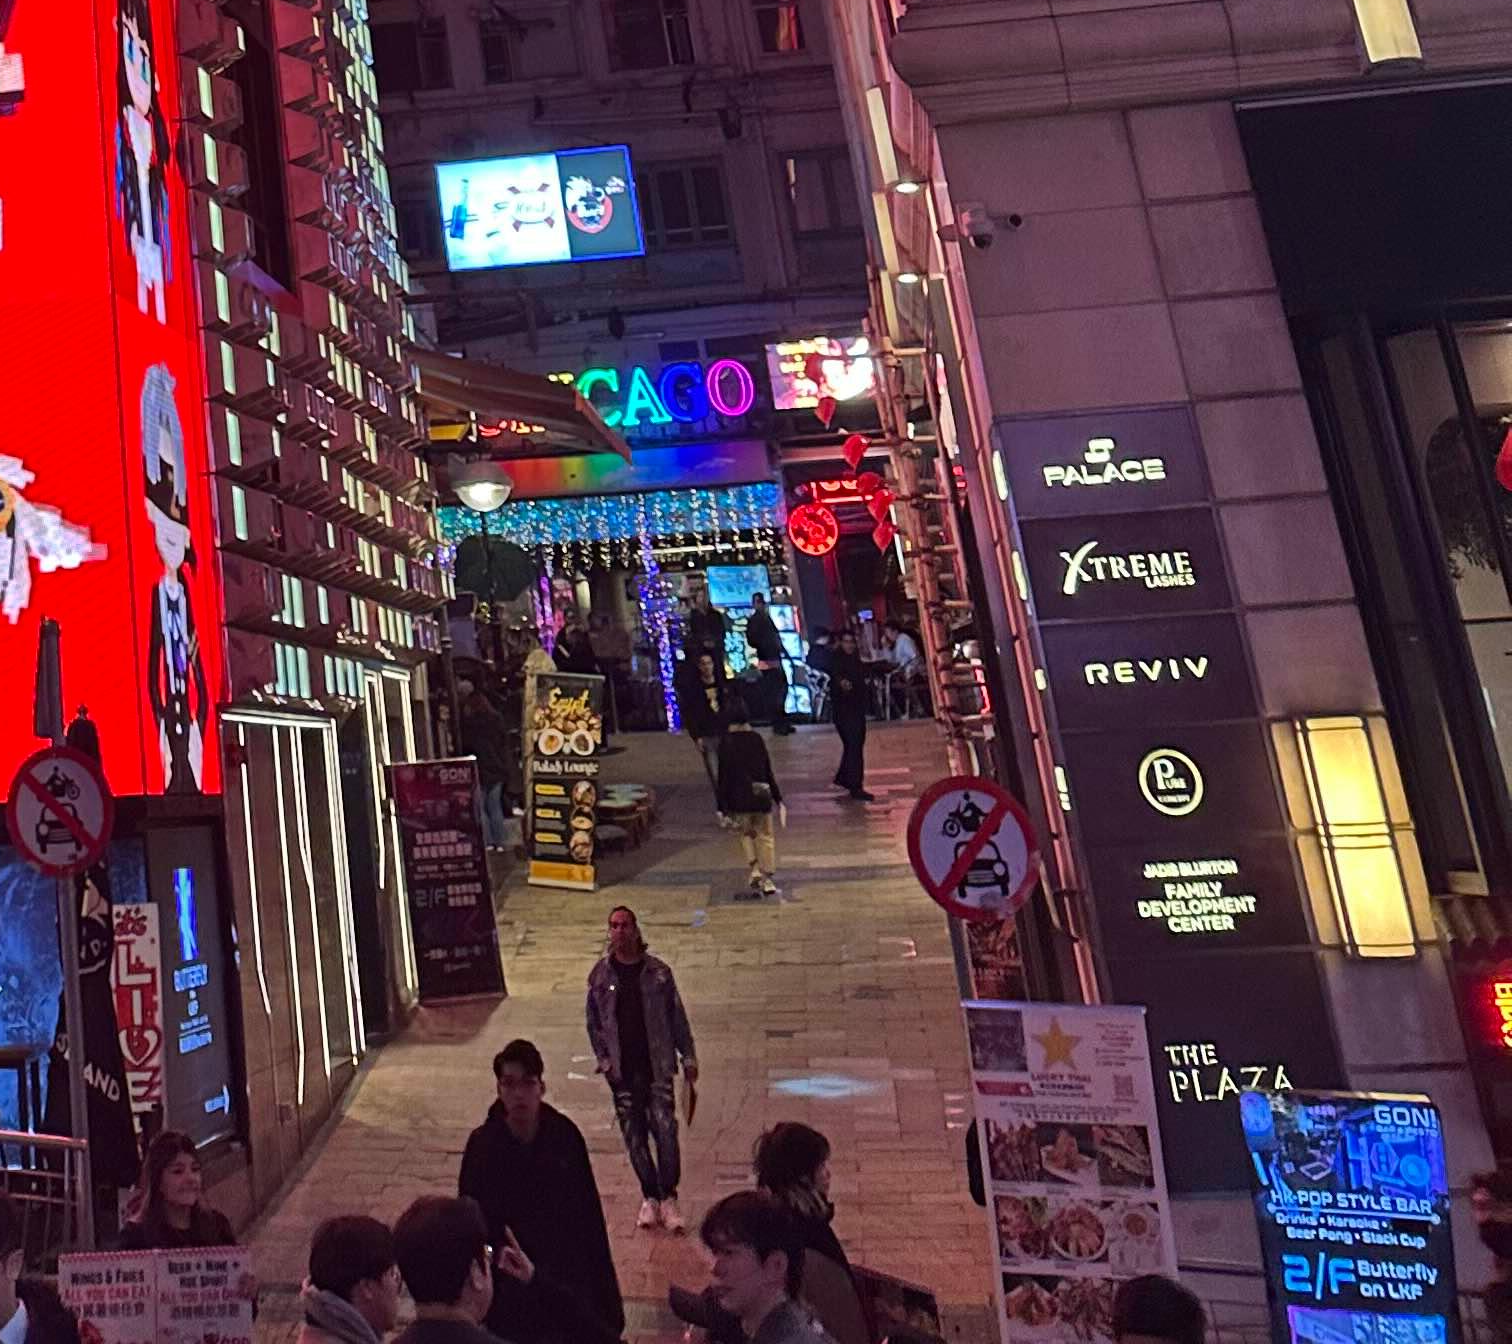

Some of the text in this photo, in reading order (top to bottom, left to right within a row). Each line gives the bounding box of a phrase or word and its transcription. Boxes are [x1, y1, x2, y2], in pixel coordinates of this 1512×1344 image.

[1042, 458, 1167, 487] PALACE
[1059, 540, 1194, 596] XTREME
[1144, 573, 1197, 589] LASHES
[1084, 656, 1209, 685] REVIV
[549, 687, 590, 716] Egypt
[564, 761, 600, 777] Lounge
[1164, 881, 1223, 900] FAMILY
[1137, 895, 1257, 918] DEVELOPMENT
[1167, 914, 1236, 933] CENTER
[1164, 1044, 1219, 1066] THE
[1168, 1065, 1294, 1103] PLAZA
[1373, 1104, 1437, 1129] GON!
[1336, 1192, 1392, 1211] STYLE
[1395, 1196, 1433, 1215] BAR
[1275, 1212, 1381, 1231] Drinks Karaoke
[1319, 1227, 1354, 1245] Pong
[1362, 1231, 1399, 1246] Stack
[1399, 1233, 1427, 1250] Cup
[1281, 1251, 1357, 1301] 2/F
[1356, 1259, 1438, 1286] Butterfly
[1359, 1282, 1424, 1301] on LKF
